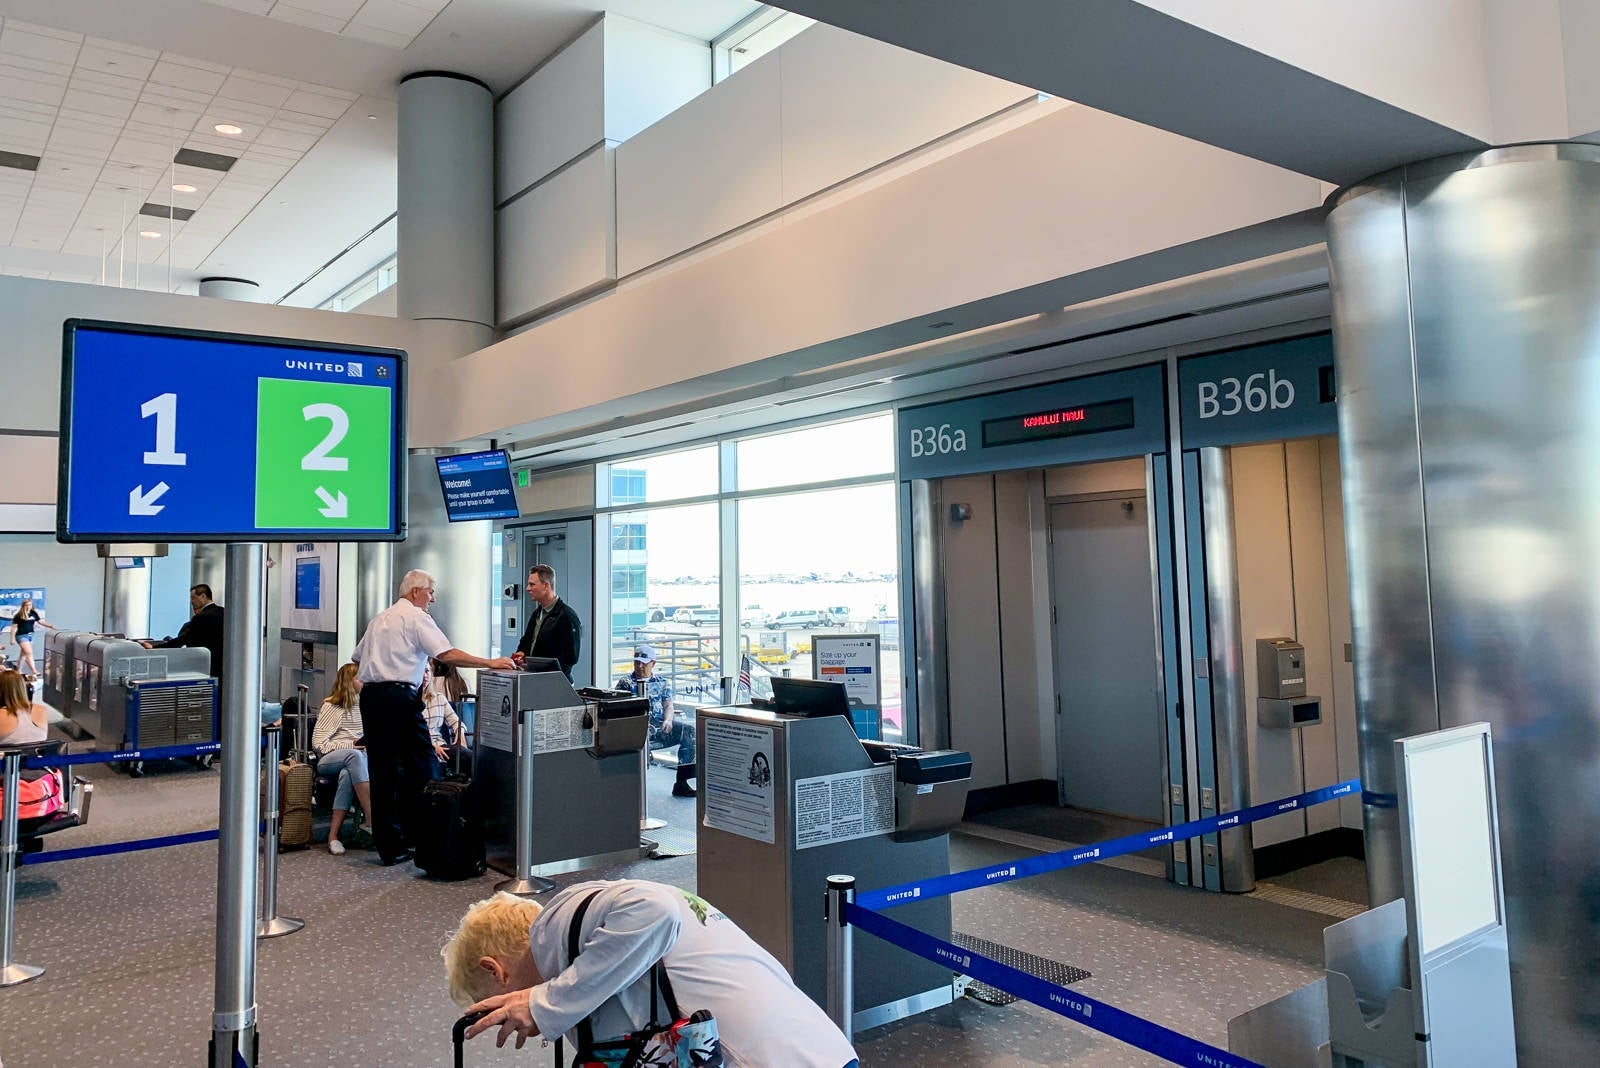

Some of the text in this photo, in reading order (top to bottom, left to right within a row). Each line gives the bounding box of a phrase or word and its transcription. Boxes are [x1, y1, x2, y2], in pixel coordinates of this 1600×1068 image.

[285, 360, 345, 373] UNITED
[1198, 369, 1295, 419] B36b
[1023, 409, 1085, 428] KAHULUI MAUI
[140, 392, 187, 466] 1
[301, 403, 349, 472] 2
[910, 424, 967, 458] B36a
[445, 479, 471, 488] Welcome!
[470, 490, 485, 498] yourself
[834, 652, 842, 660] up
[843, 651, 857, 659] your
[1150, 834, 1168, 843] UNITED
[1073, 851, 1094, 860] UNITED
[986, 870, 1009, 880] UNITED
[887, 891, 912, 901] UNITED
[936, 947, 962, 963] UNITED
[1050, 992, 1082, 1011] UNITED
